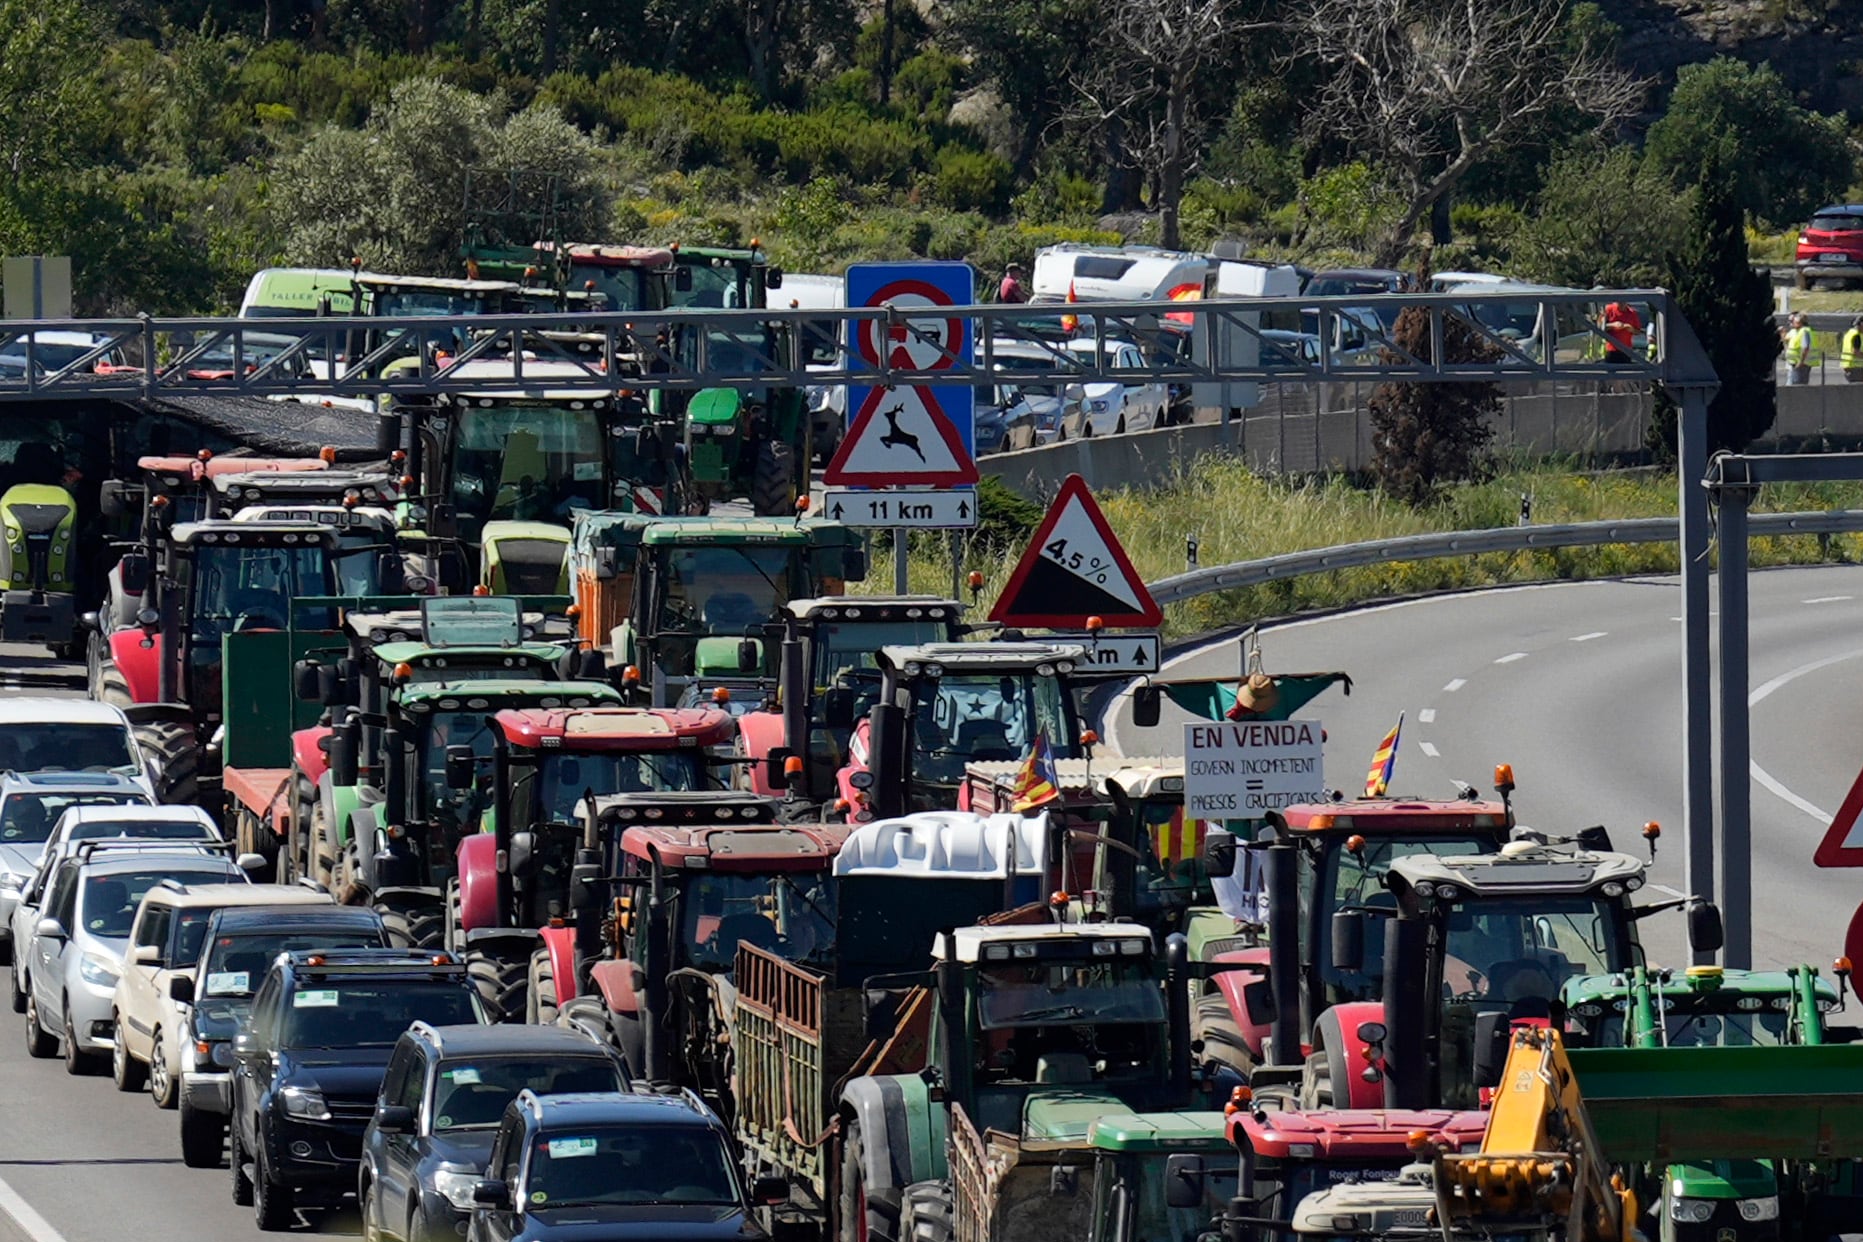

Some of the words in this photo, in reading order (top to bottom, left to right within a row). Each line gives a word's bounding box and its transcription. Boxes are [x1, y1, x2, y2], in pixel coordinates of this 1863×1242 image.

[868, 501, 888, 519] 11
[899, 500, 933, 520] km
[1192, 726, 1222, 749] EN
[1233, 724, 1314, 747] VENDA
[1190, 760, 1235, 776] GOVERN
[1240, 758, 1316, 775] INCOMPETENT
[1191, 794, 1238, 811] PAGESOS
